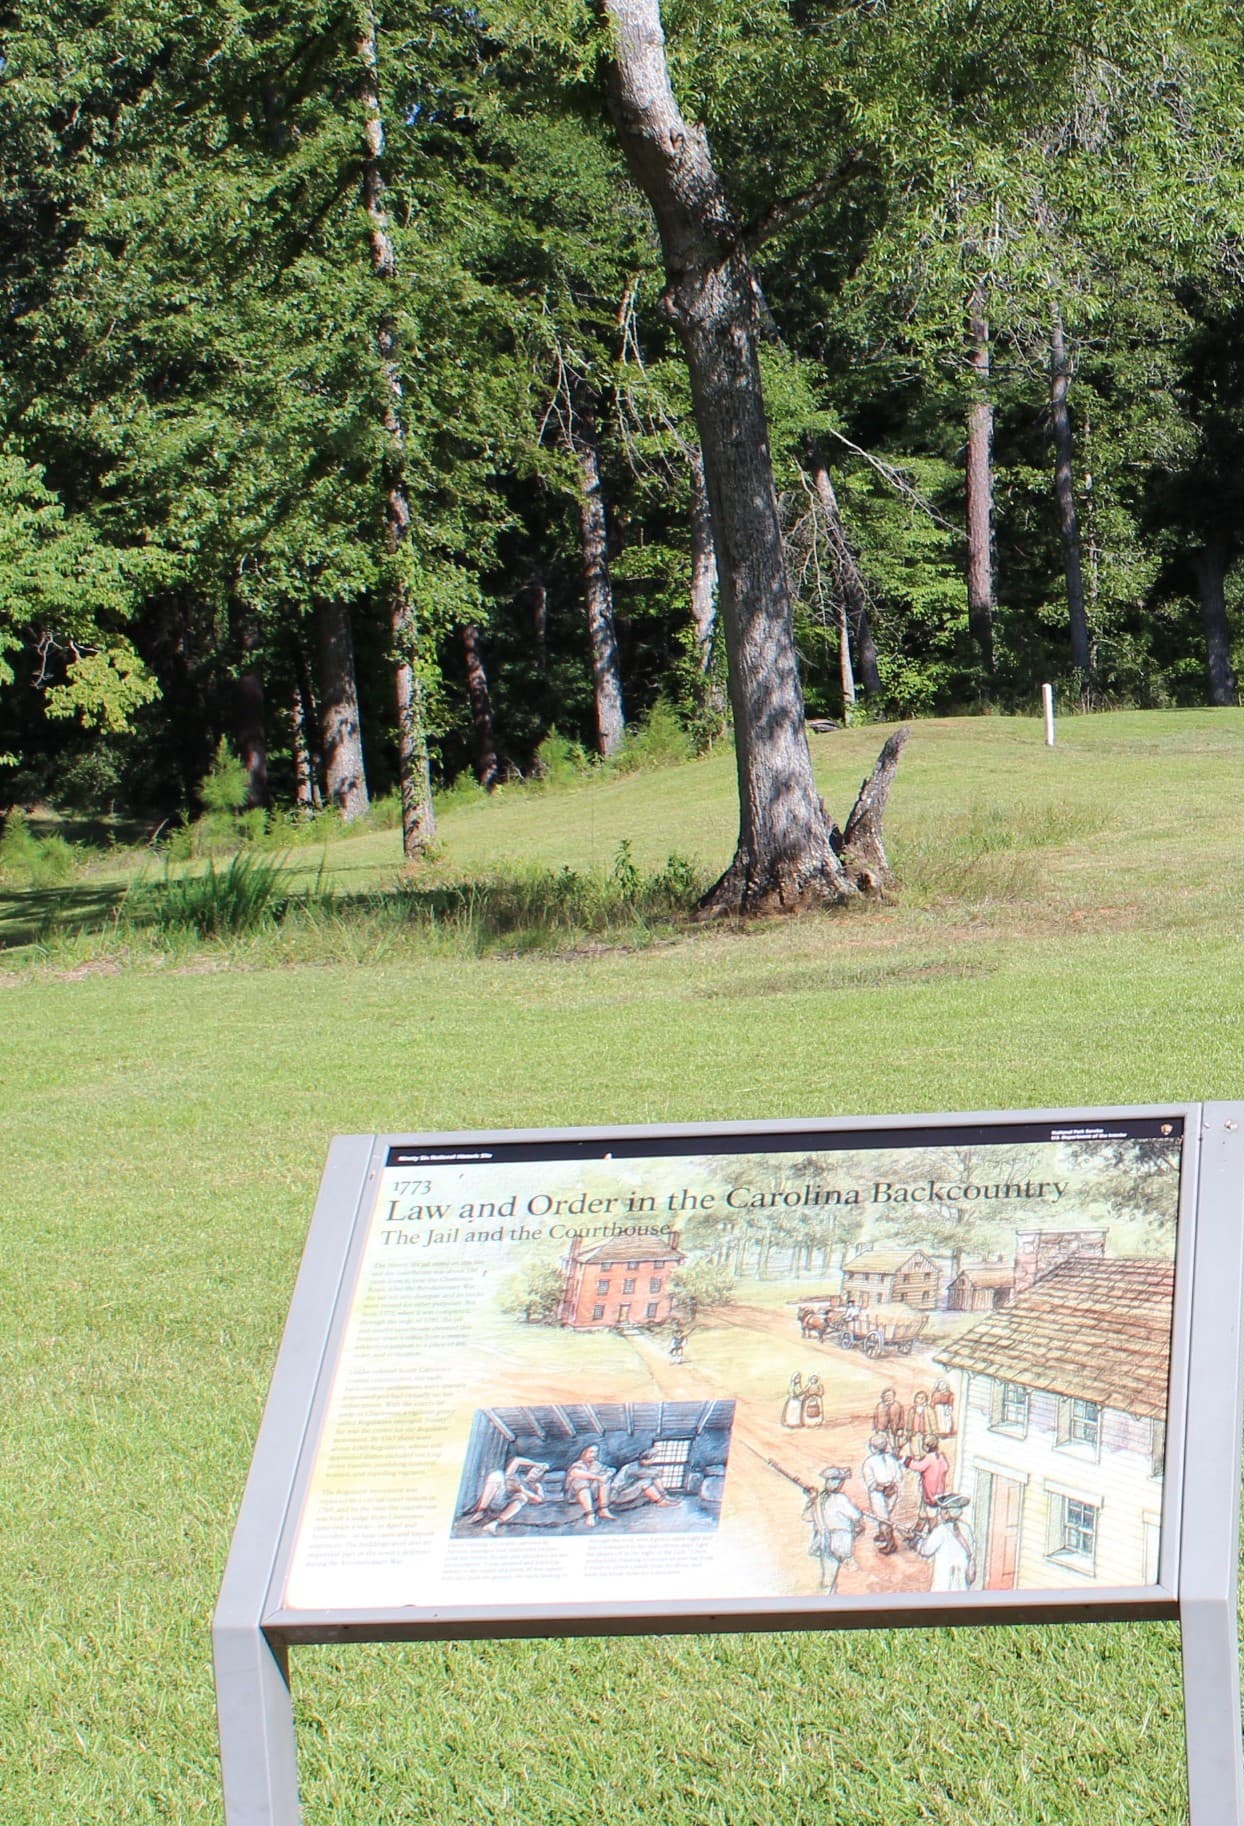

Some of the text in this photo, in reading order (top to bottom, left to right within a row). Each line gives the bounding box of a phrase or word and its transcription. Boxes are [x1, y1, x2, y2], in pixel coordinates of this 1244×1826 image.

[393, 1180, 432, 1195] 1773
[386, 1180, 1070, 1221] Law and Order in the Carolina Backcountry
[381, 1222, 671, 1247] The Jail and the Courthouse
